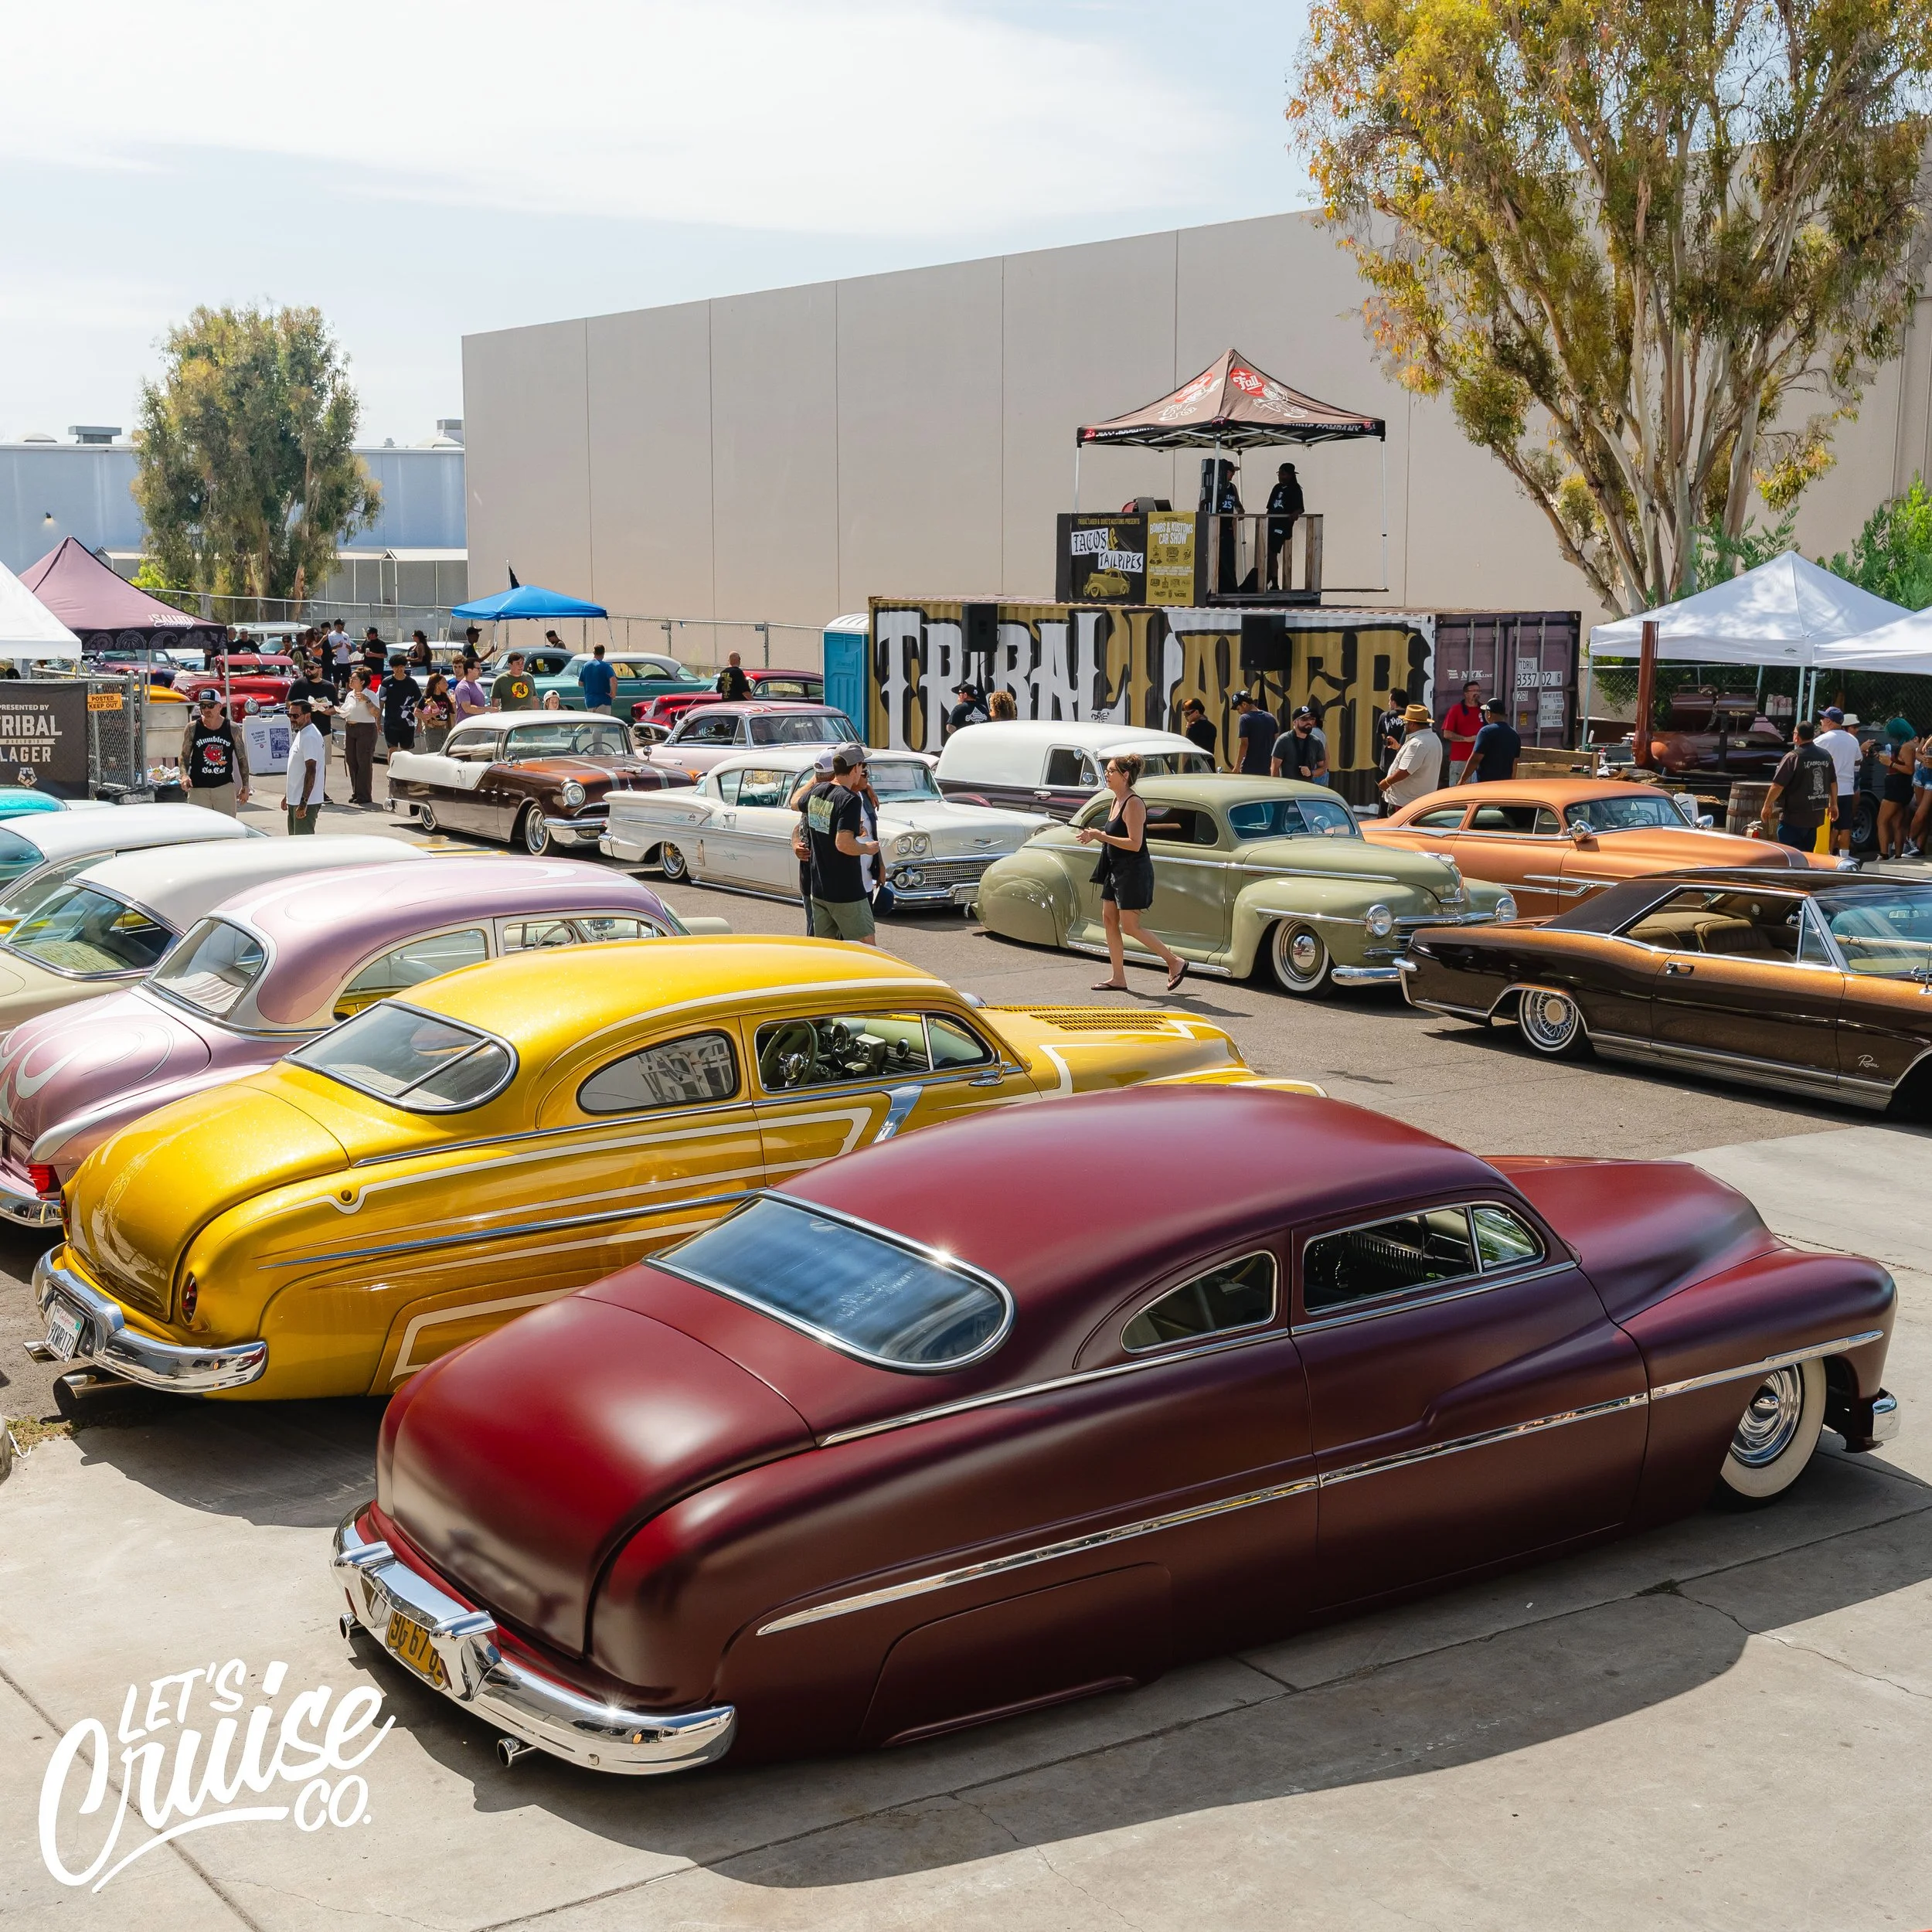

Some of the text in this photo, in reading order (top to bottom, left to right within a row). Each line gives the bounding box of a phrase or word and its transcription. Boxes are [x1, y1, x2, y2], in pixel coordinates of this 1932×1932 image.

[1222, 501, 1233, 509] 25
[1149, 521, 1194, 534] BOMBS & KUSTOMS
[1073, 527, 1119, 552] TACOS &
[1159, 532, 1188, 545] CAR SHOW
[1099, 552, 1142, 570] TAILPIPES
[0, 747, 52, 763] LAGER
